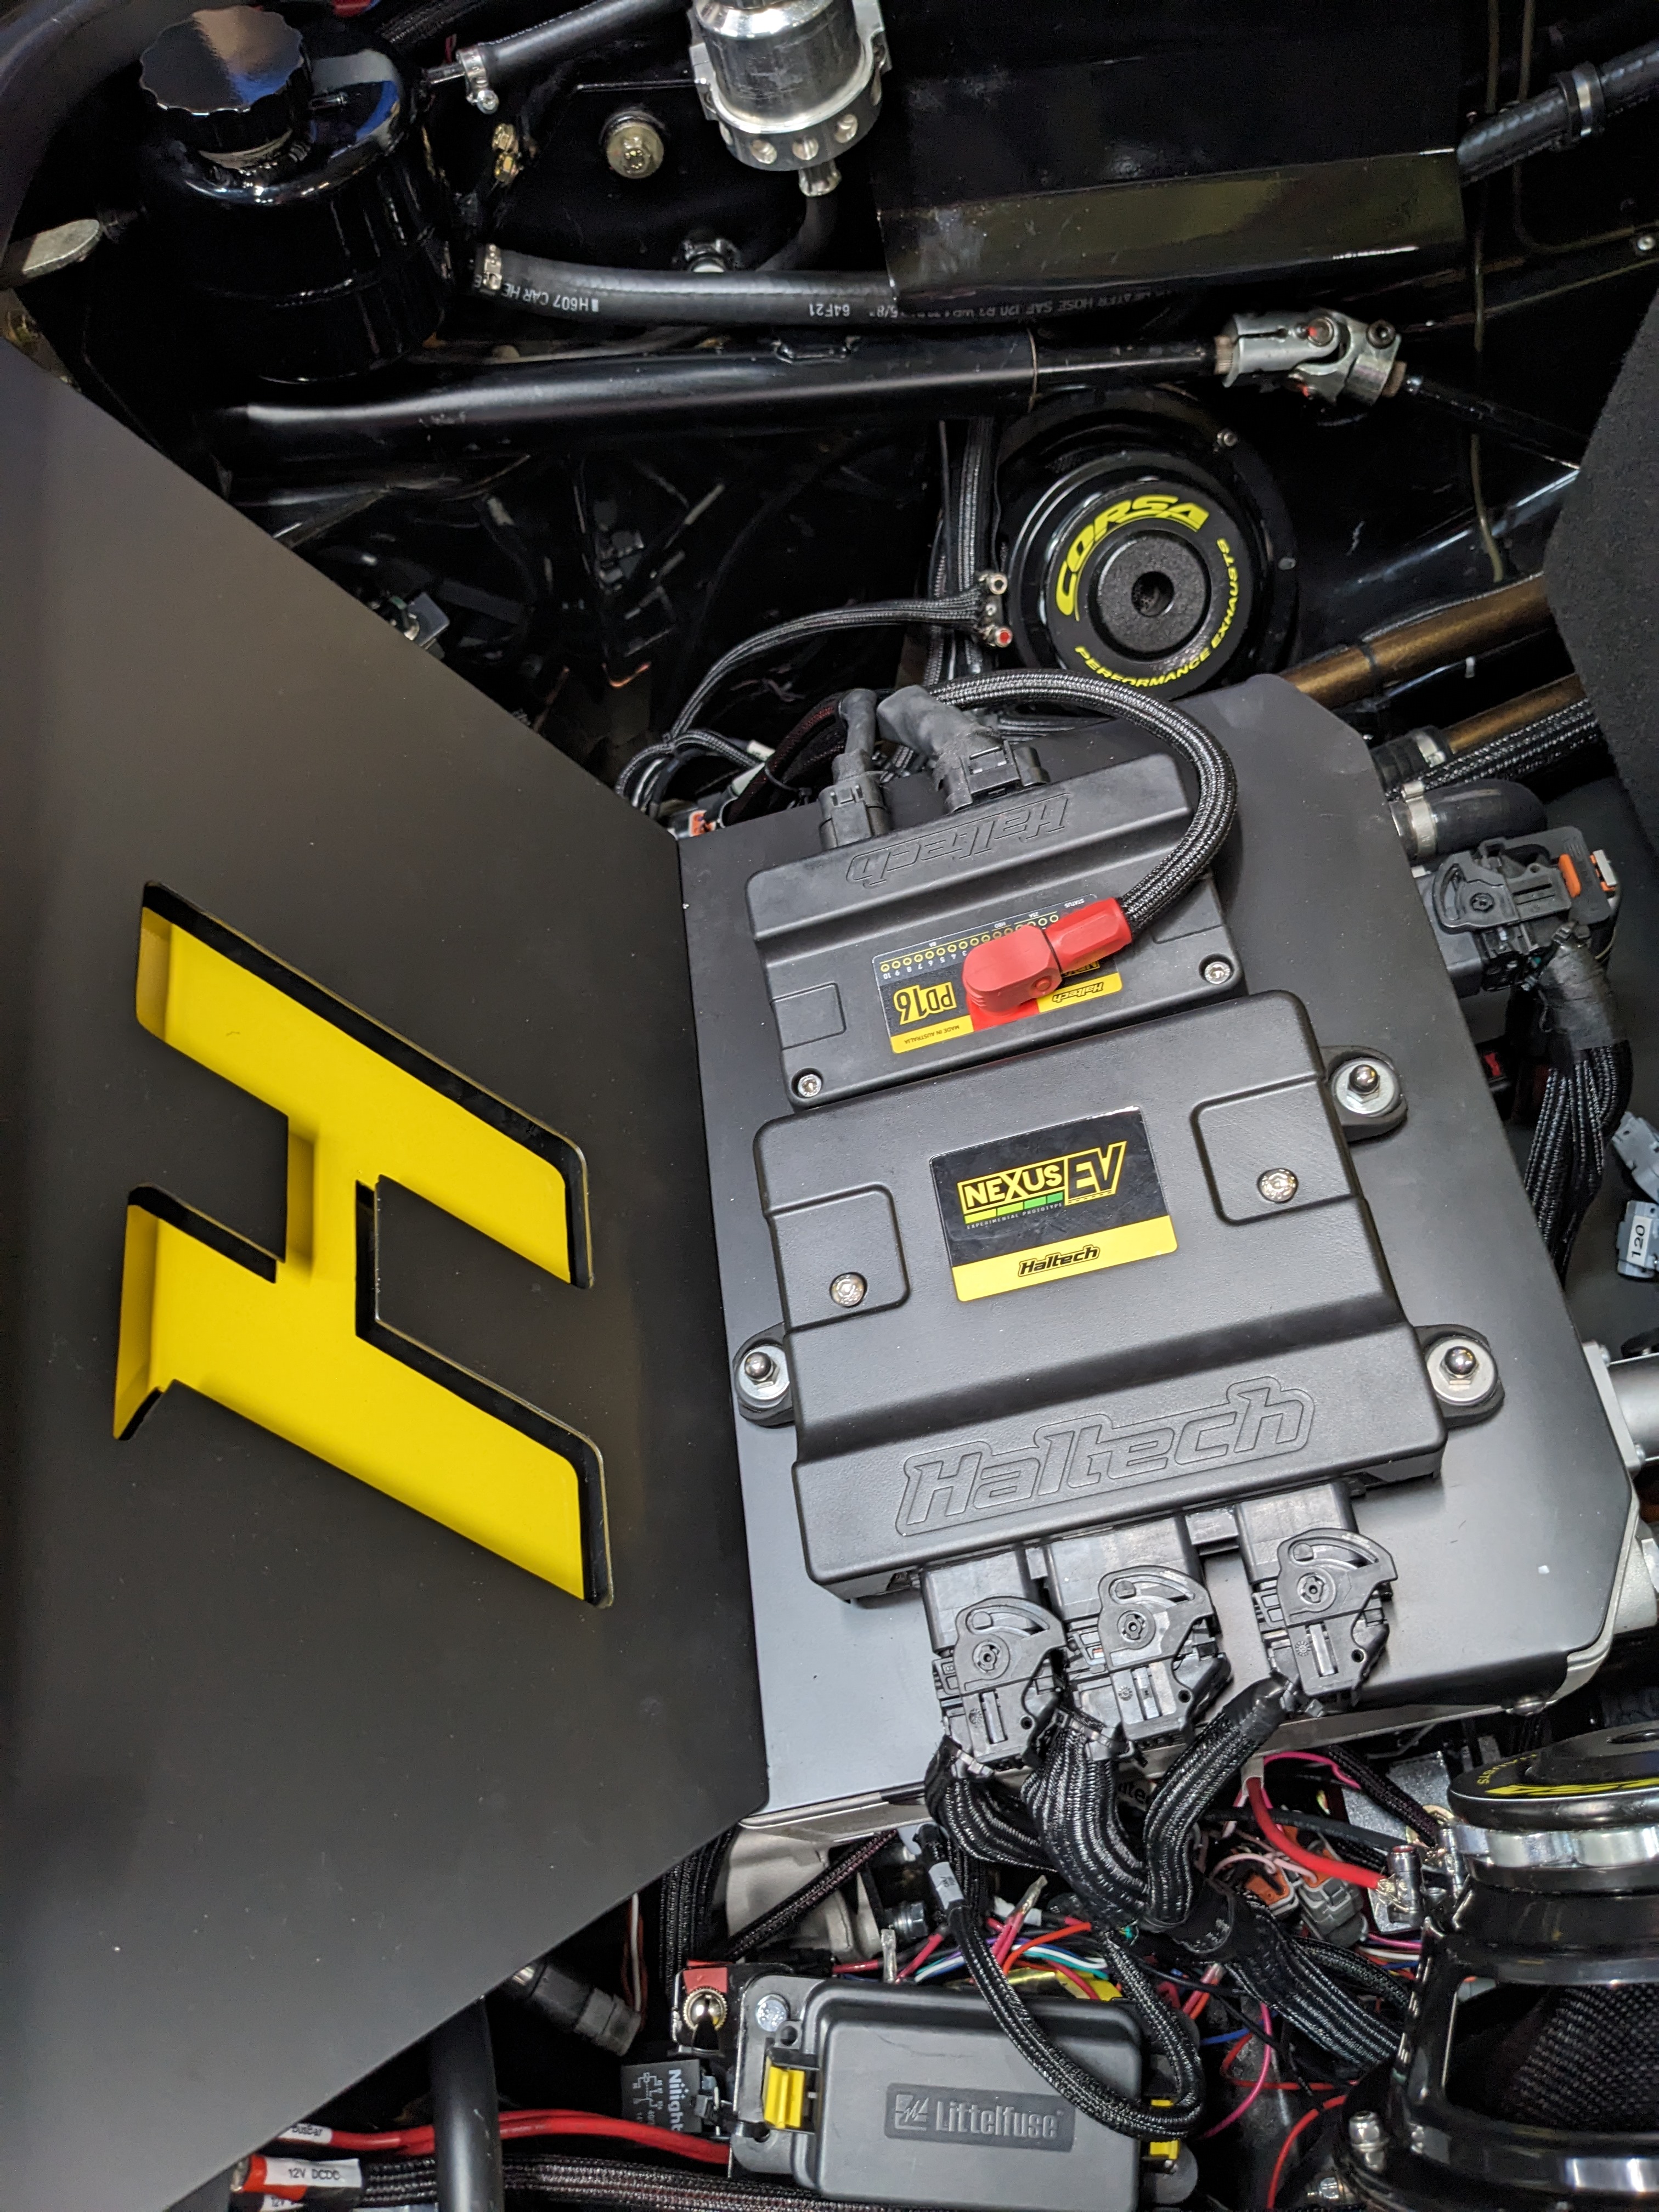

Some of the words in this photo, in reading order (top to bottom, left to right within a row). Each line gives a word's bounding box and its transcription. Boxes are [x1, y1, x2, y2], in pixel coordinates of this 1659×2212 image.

[522, 289, 549, 306] CAR
[552, 295, 589, 312] H607
[808, 303, 851, 318] 64F21
[1056, 494, 1209, 620] CORSA
[1210, 538, 1239, 649] EXHAUSTS
[848, 793, 1070, 884] Haltech
[1064, 898, 1085, 909] STATUS
[895, 983, 955, 1023] PD16
[1052, 982, 1104, 1003] Haltech
[904, 1032, 935, 1045] AUSTRALIA
[943, 1024, 960, 1032] MADE
[964, 1164, 1064, 1209] NEXUS
[1068, 1142, 1126, 1200] EV
[967, 1213, 1019, 1230] EXPERIMENTAL
[1022, 1203, 1063, 1216] PROTOTYPE
[1630, 1224, 1646, 1259] 120
[1018, 1245, 1100, 1277] Haltech
[901, 1380, 1310, 1532] Haltech
[936, 2100, 1058, 2140] Littelfuse
[288, 2168, 306, 2179] 12V
[312, 2168, 340, 2181] DCDC
